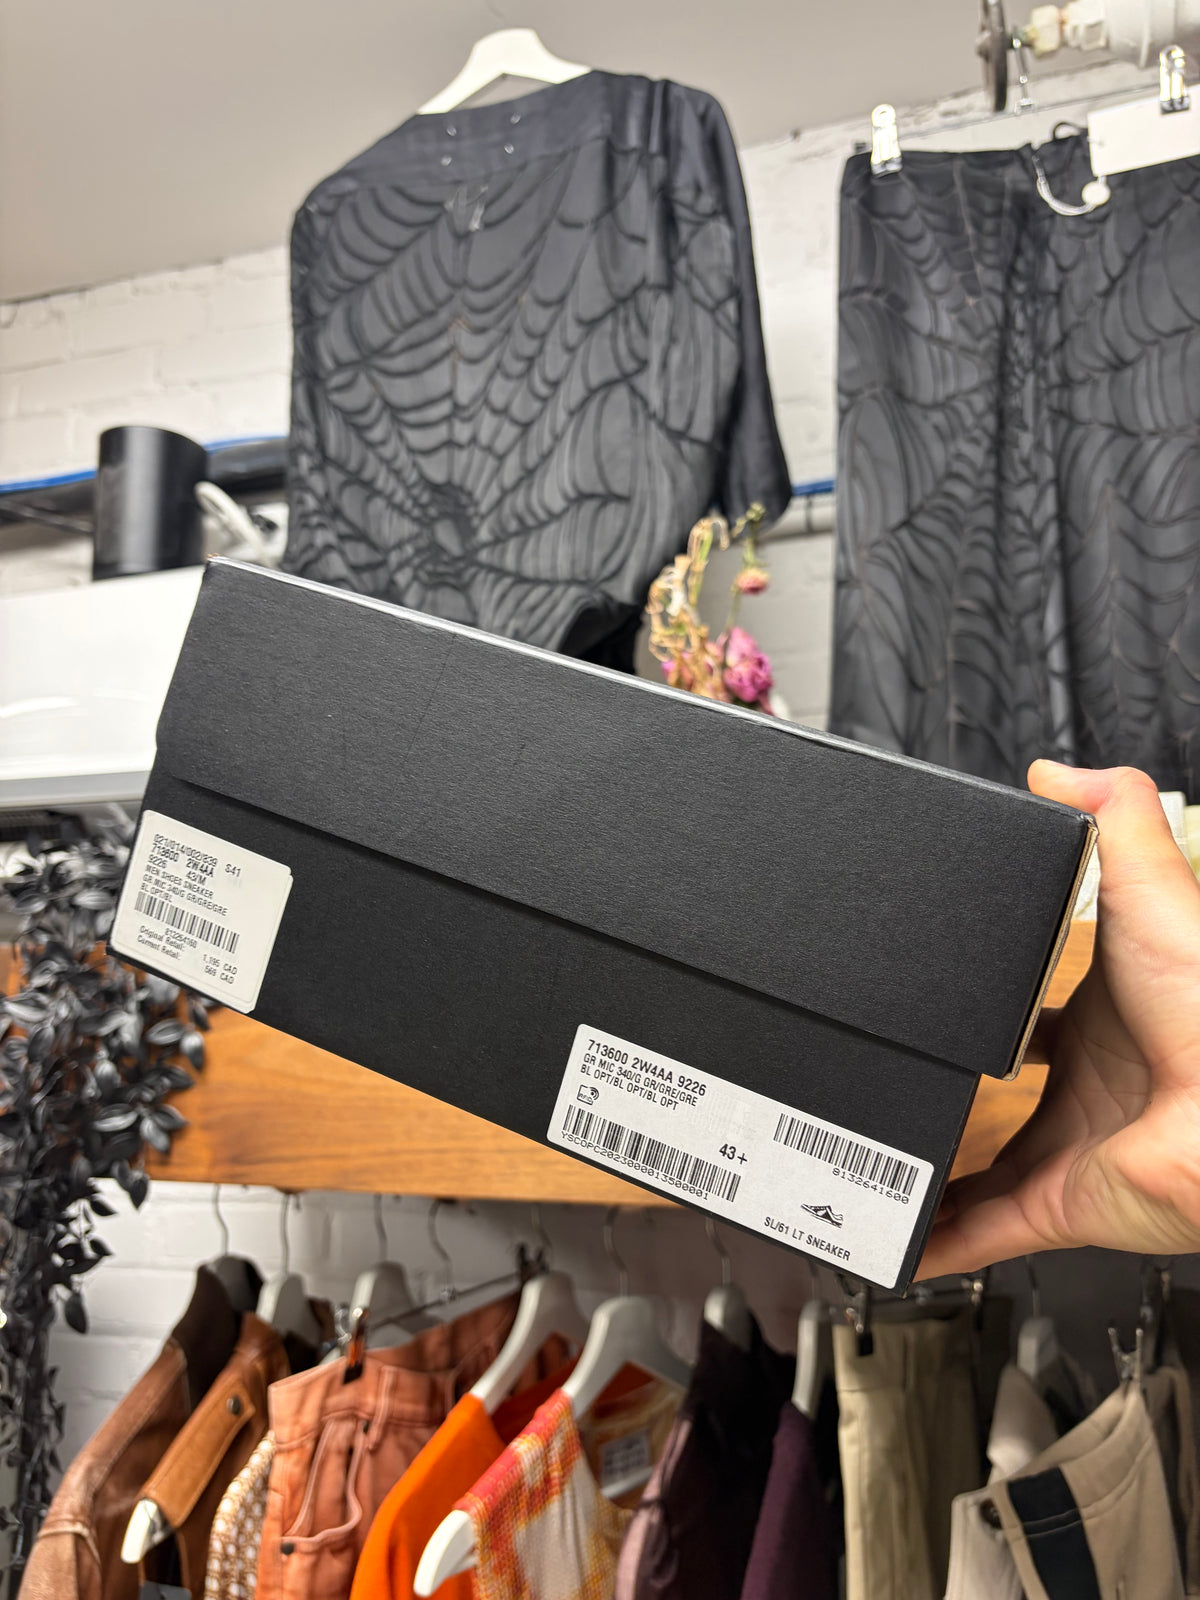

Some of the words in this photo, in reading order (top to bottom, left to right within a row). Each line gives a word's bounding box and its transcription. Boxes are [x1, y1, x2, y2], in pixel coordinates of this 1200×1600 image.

[148, 854, 167, 869] 9226
[152, 842, 179, 862] 713600
[186, 858, 214, 877] 2W4AA
[225, 864, 241, 877] S41
[146, 864, 160, 876] MEN
[161, 871, 182, 886] SHOES
[183, 881, 214, 899] SNEAKER
[137, 935, 161, 951] Current
[220, 973, 235, 984] CAD
[140, 925, 164, 942] Original
[223, 964, 238, 975] CAD
[580, 1064, 592, 1076] BL
[594, 1070, 624, 1090] OPT/BL
[626, 1082, 658, 1104] OPT/BL
[660, 1096, 679, 1111] OPT
[583, 1053, 596, 1066] GR
[597, 1058, 614, 1073] MIC
[616, 1066, 642, 1083] 340/G
[644, 1077, 698, 1107] GR/GRE/GRE
[587, 1039, 629, 1065] 713600
[631, 1057, 674, 1083] 2W4AA
[677, 1076, 707, 1096] 9226
[719, 1143, 748, 1165] 43+
[831, 1167, 910, 1205] 8132641600
[764, 1216, 790, 1235] SL/61
[792, 1228, 805, 1241] LT
[806, 1234, 851, 1261] SNEAKER
